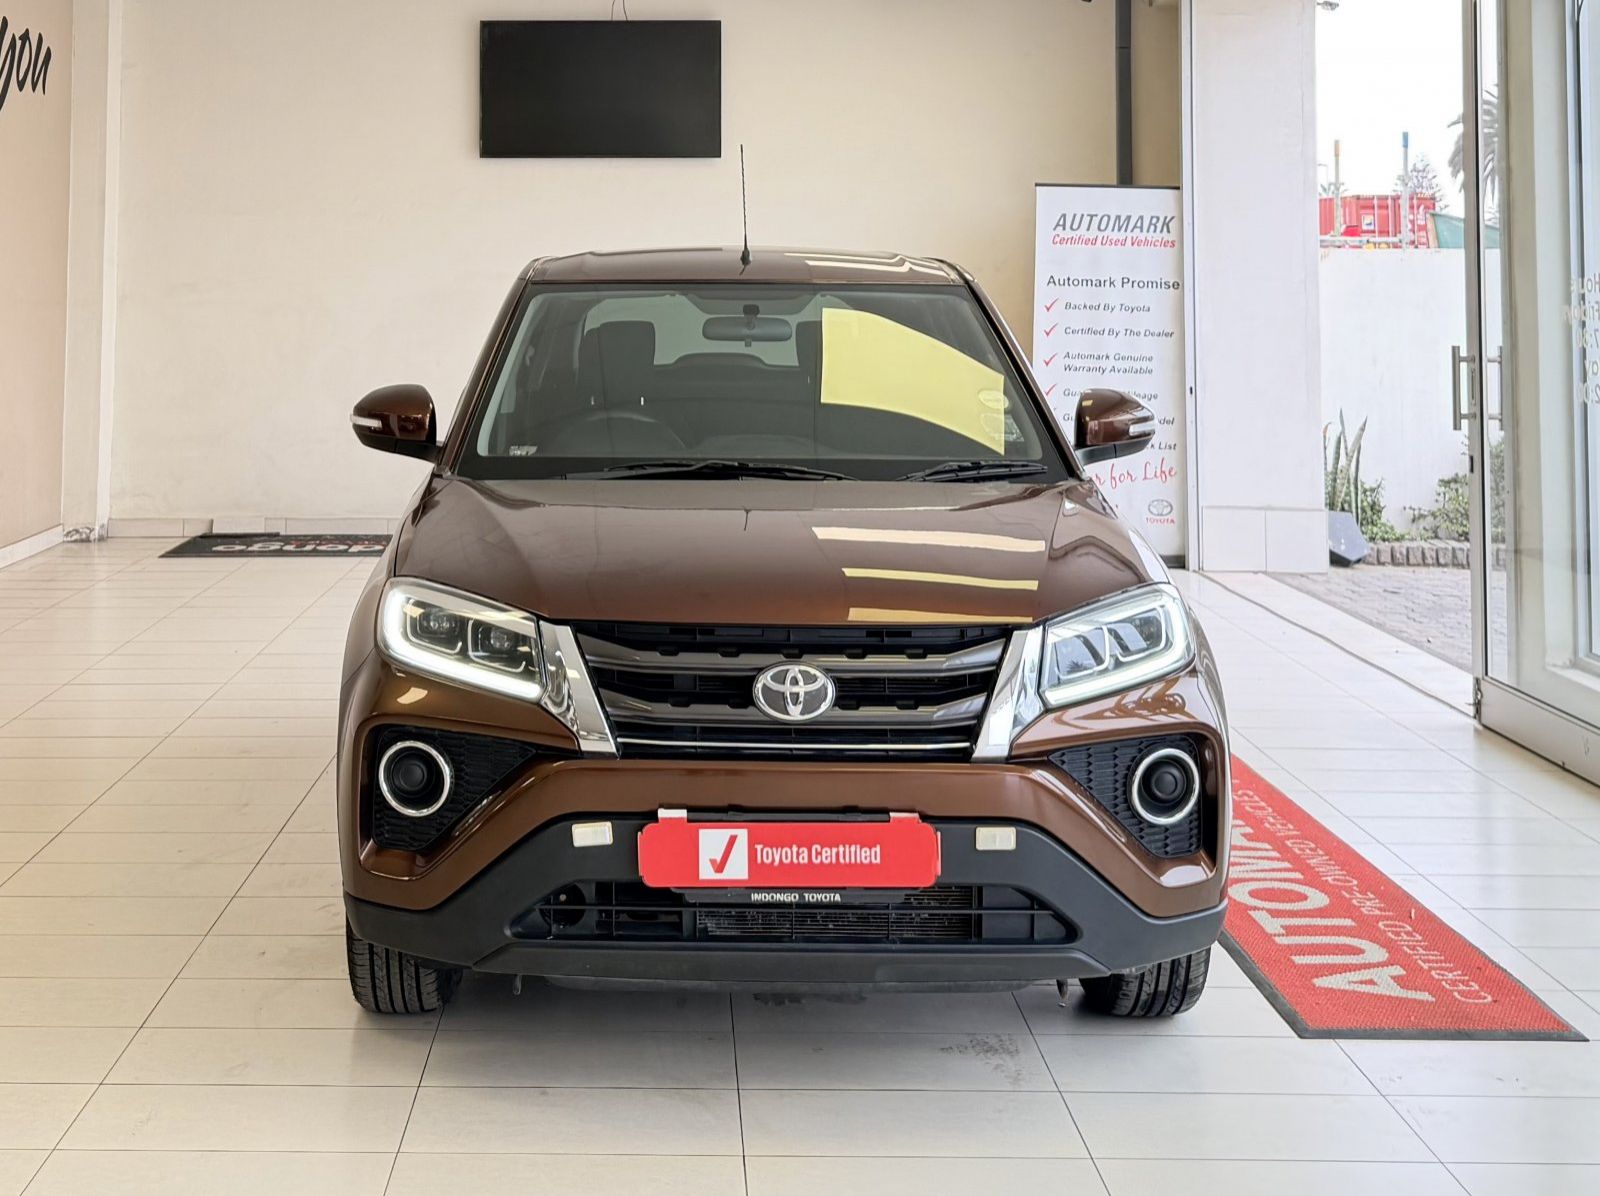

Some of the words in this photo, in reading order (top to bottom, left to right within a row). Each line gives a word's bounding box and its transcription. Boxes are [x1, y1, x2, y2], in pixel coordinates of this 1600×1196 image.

[1053, 213, 1176, 234] AUTOMARK
[1052, 233, 1098, 246] Certified
[1100, 235, 1127, 247] Used
[1130, 236, 1176, 248] Vehicles
[1047, 275, 1116, 288] Automark
[1121, 277, 1180, 290] Promise
[1064, 302, 1101, 311] Backed
[1103, 303, 1116, 313] By
[1119, 304, 1151, 314] Toyota
[1064, 326, 1106, 337] Certified
[1107, 328, 1120, 338] By
[1124, 328, 1141, 337] The
[1143, 329, 1174, 338] Dealer
[1063, 351, 1110, 361] Automark
[1113, 353, 1154, 363] Genuine
[1063, 364, 1107, 376] Warranty
[1109, 366, 1154, 376] Available
[1158, 443, 1177, 451] List
[1110, 463, 1137, 490] for
[1142, 457, 1178, 483] Life
[1146, 517, 1176, 525] TOYOTA
[754, 844, 808, 866] Toyota
[811, 844, 881, 865] Certified
[751, 892, 799, 902] INDONGO
[803, 892, 841, 902] TOYOTA
[1378, 920, 1493, 1003] CERTIFIED
